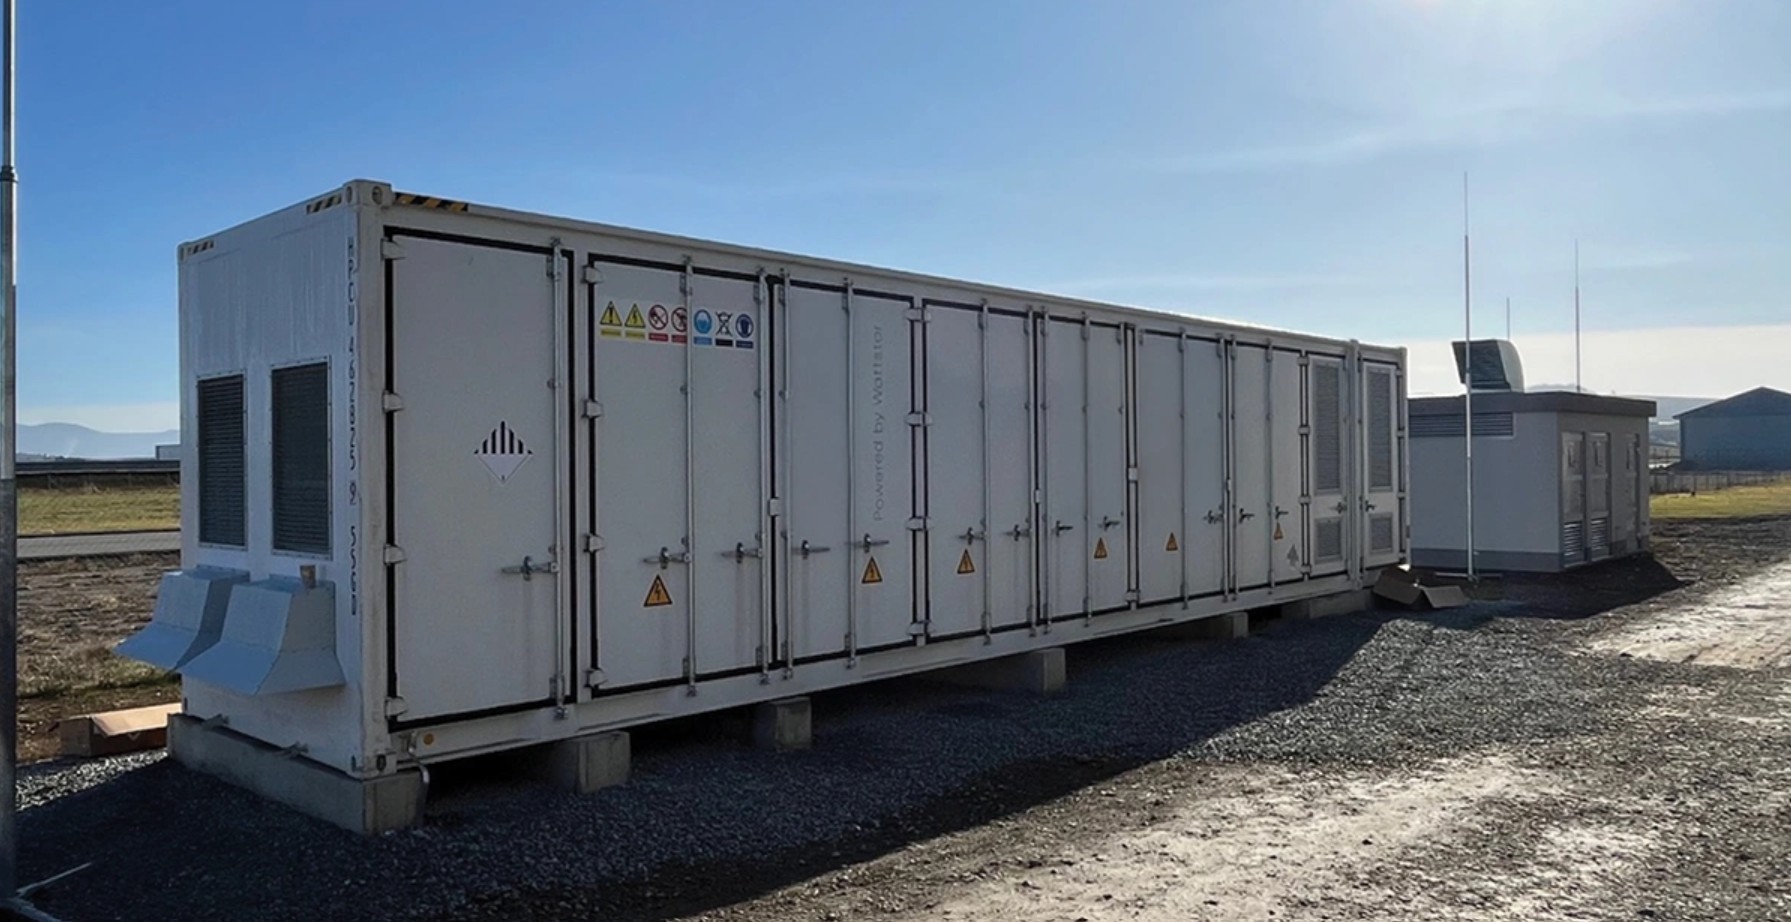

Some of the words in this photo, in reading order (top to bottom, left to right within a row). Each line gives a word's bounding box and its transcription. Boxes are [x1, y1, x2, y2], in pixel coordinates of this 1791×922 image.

[348, 335, 357, 471] 462825
[872, 324, 883, 405] Wattstor
[872, 406, 886, 434] by
[873, 441, 884, 521] Powered
